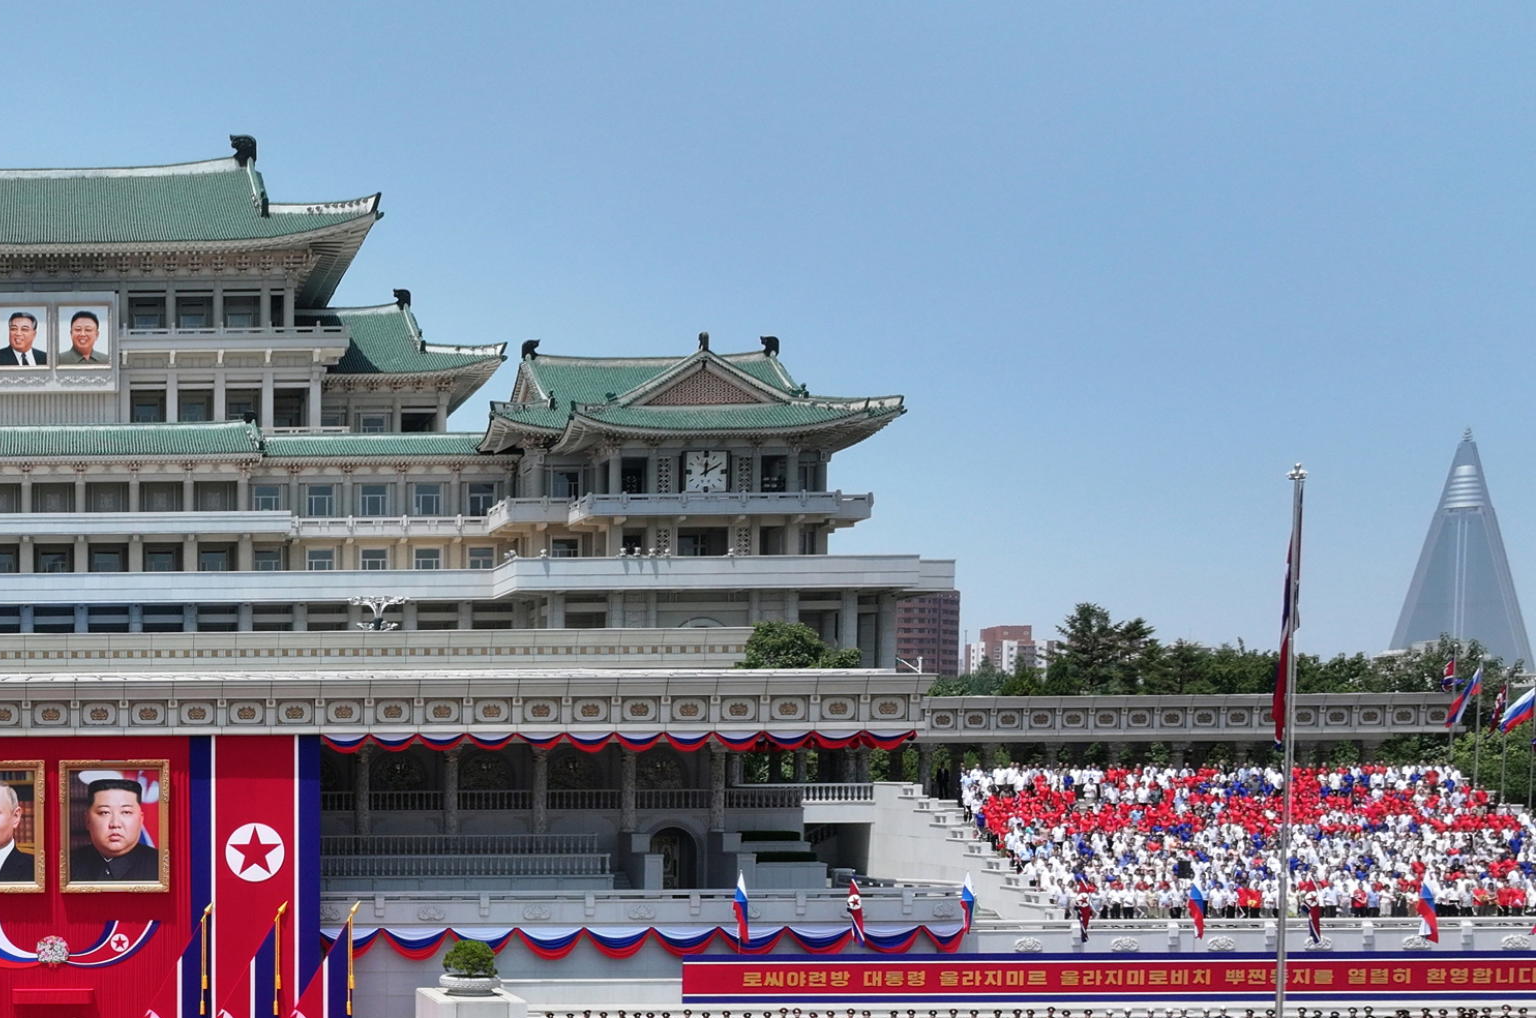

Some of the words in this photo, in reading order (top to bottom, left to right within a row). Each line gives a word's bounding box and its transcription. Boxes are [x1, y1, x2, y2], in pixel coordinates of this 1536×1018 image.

[742, 971, 851, 987] 로씨야련방
[863, 970, 926, 987] 대통령
[939, 970, 1048, 987] 울라지미르
[1060, 969, 1211, 986] 울라지미로비치
[1348, 967, 1412, 985] 열렬히
